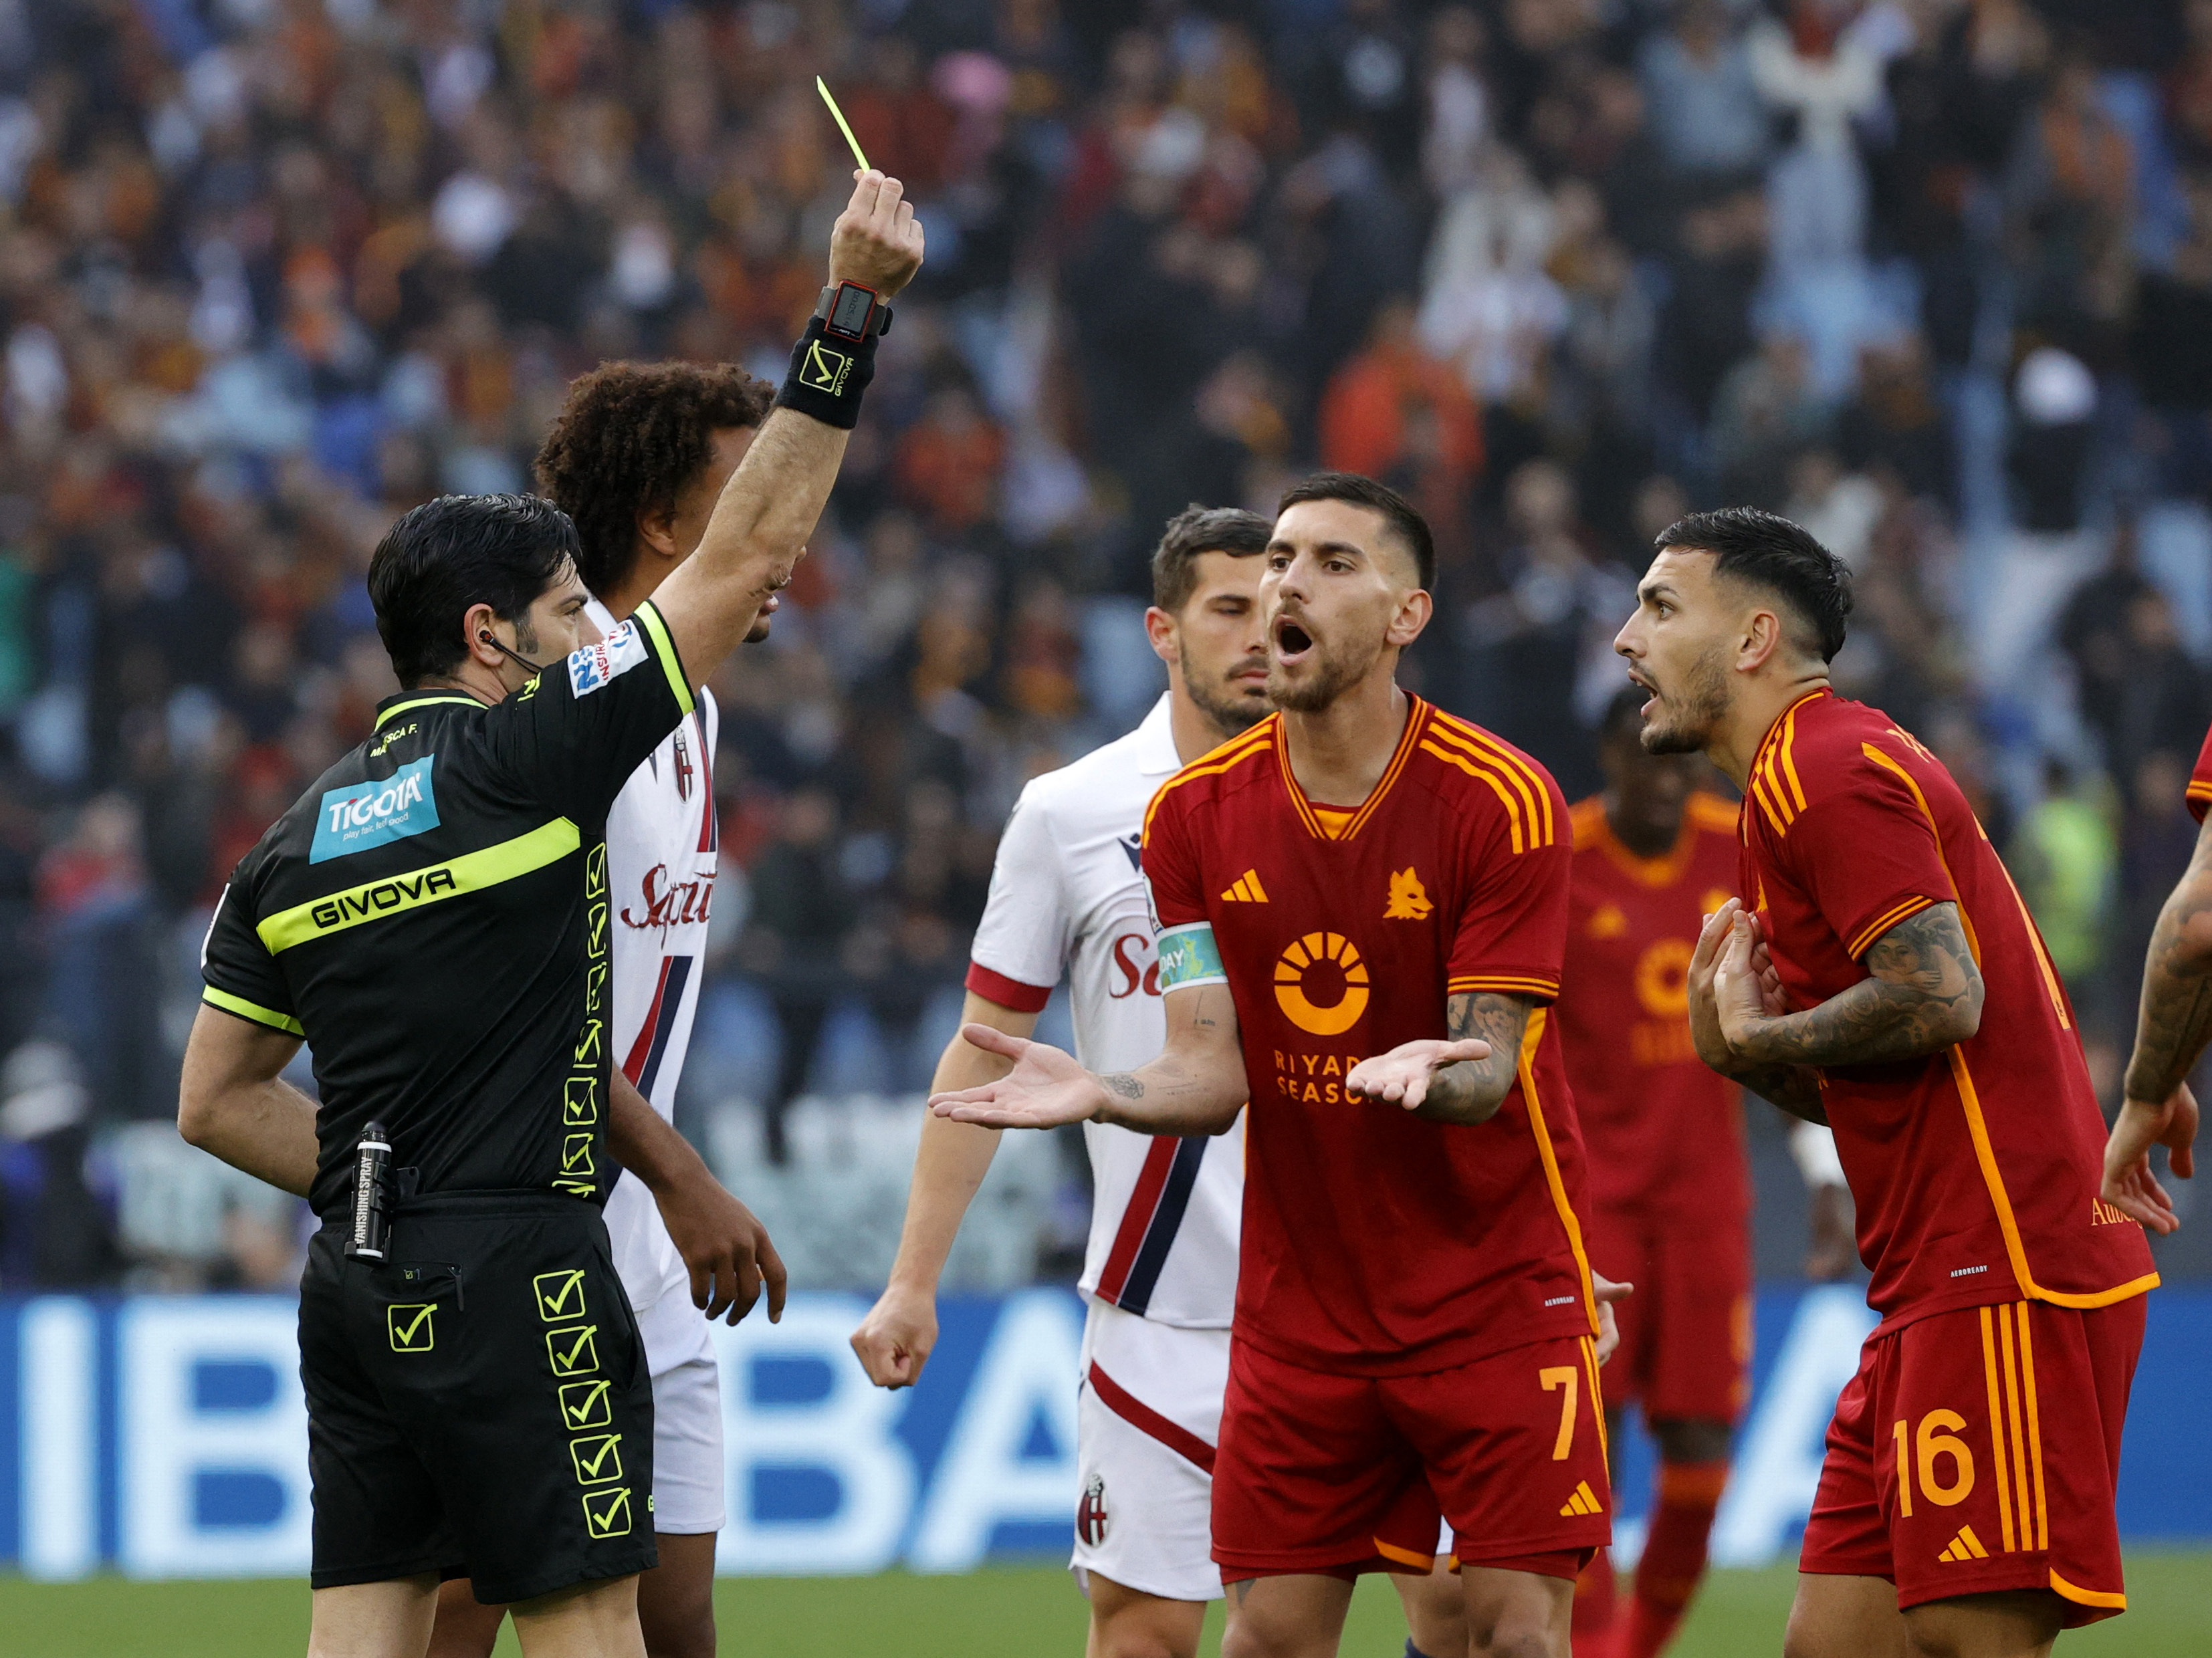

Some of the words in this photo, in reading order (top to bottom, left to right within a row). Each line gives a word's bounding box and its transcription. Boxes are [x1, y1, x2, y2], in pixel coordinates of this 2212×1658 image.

[835, 357, 854, 396] GIVOVA
[408, 723, 417, 734] F.
[342, 830, 360, 842] play
[361, 824, 374, 835] fair,
[376, 818, 387, 829] feel
[389, 812, 409, 826] good
[312, 868, 456, 929] GIVOVA
[359, 1157, 372, 1189] SPRAY
[354, 1190, 369, 1244] VANISHING
[1951, 1265, 1987, 1278] AEROREADY
[1539, 1366, 1578, 1461] 7
[1893, 1409, 1975, 1518] 16
